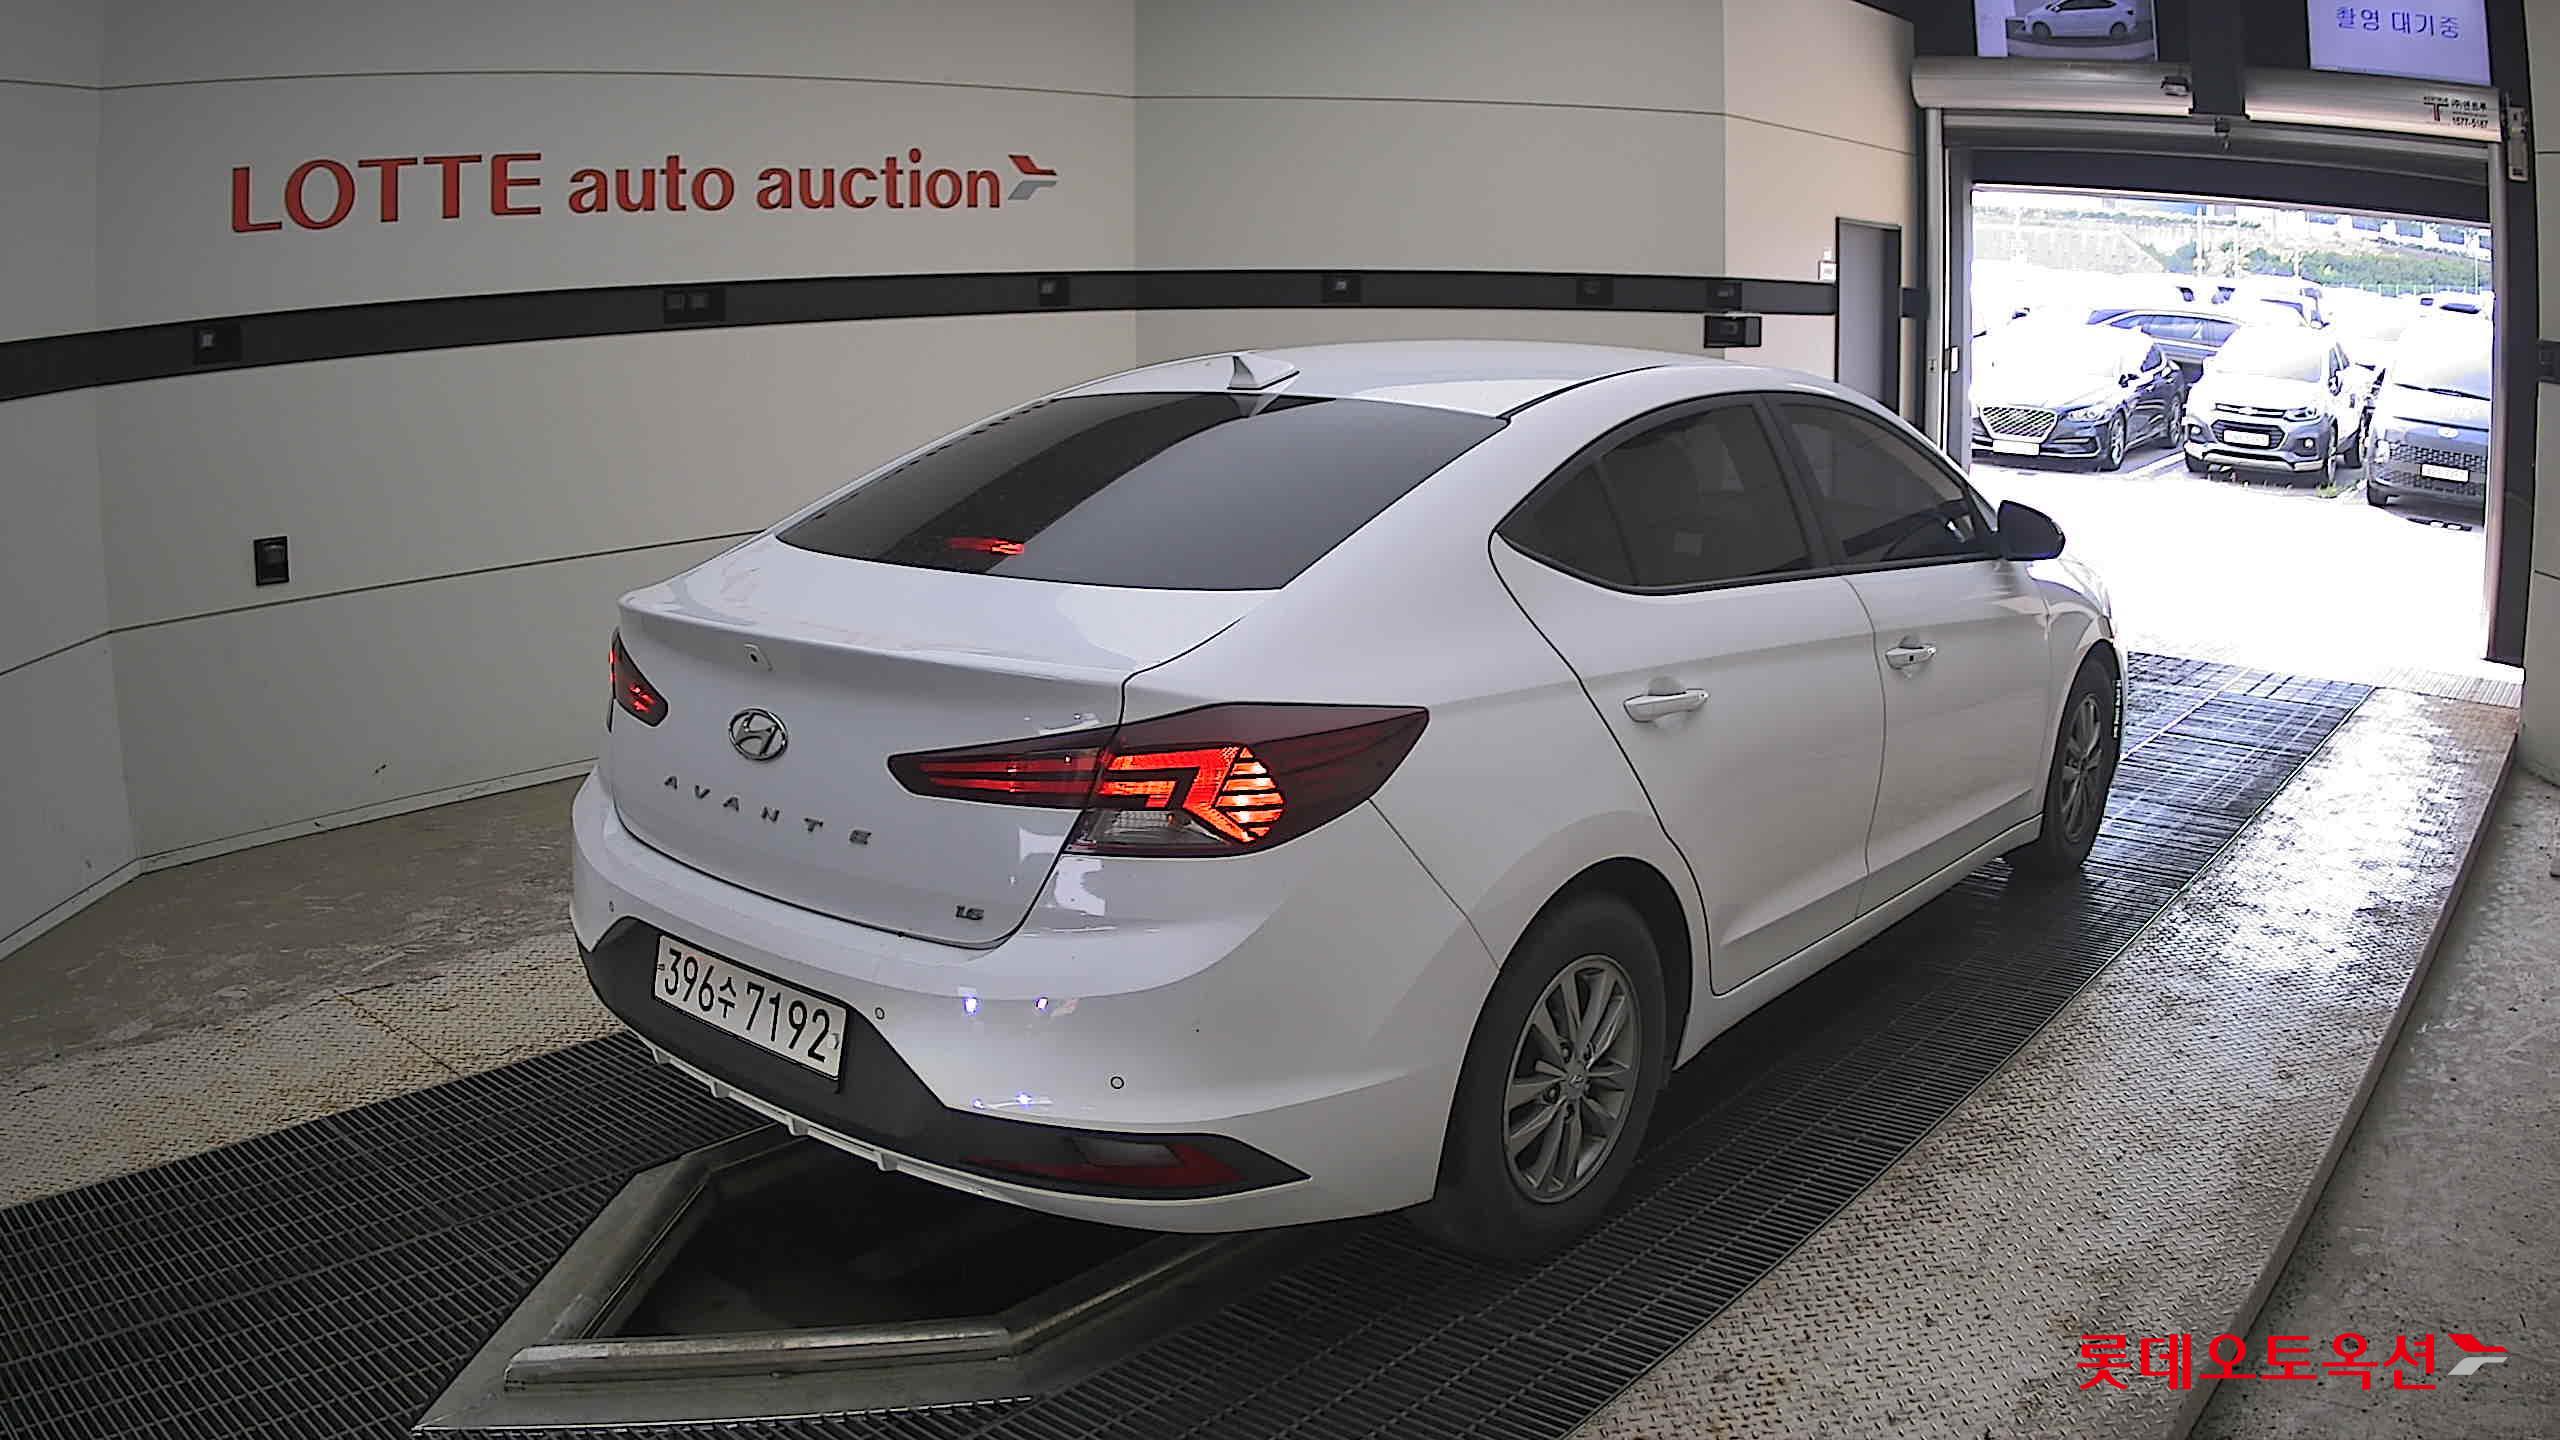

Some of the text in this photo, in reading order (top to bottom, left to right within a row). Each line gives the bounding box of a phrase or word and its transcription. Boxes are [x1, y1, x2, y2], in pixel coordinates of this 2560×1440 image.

[2337, 6, 2460, 39] 촬영 대기중
[231, 147, 1001, 233] LOTTE auto auction
[664, 775, 872, 845] AVANTE
